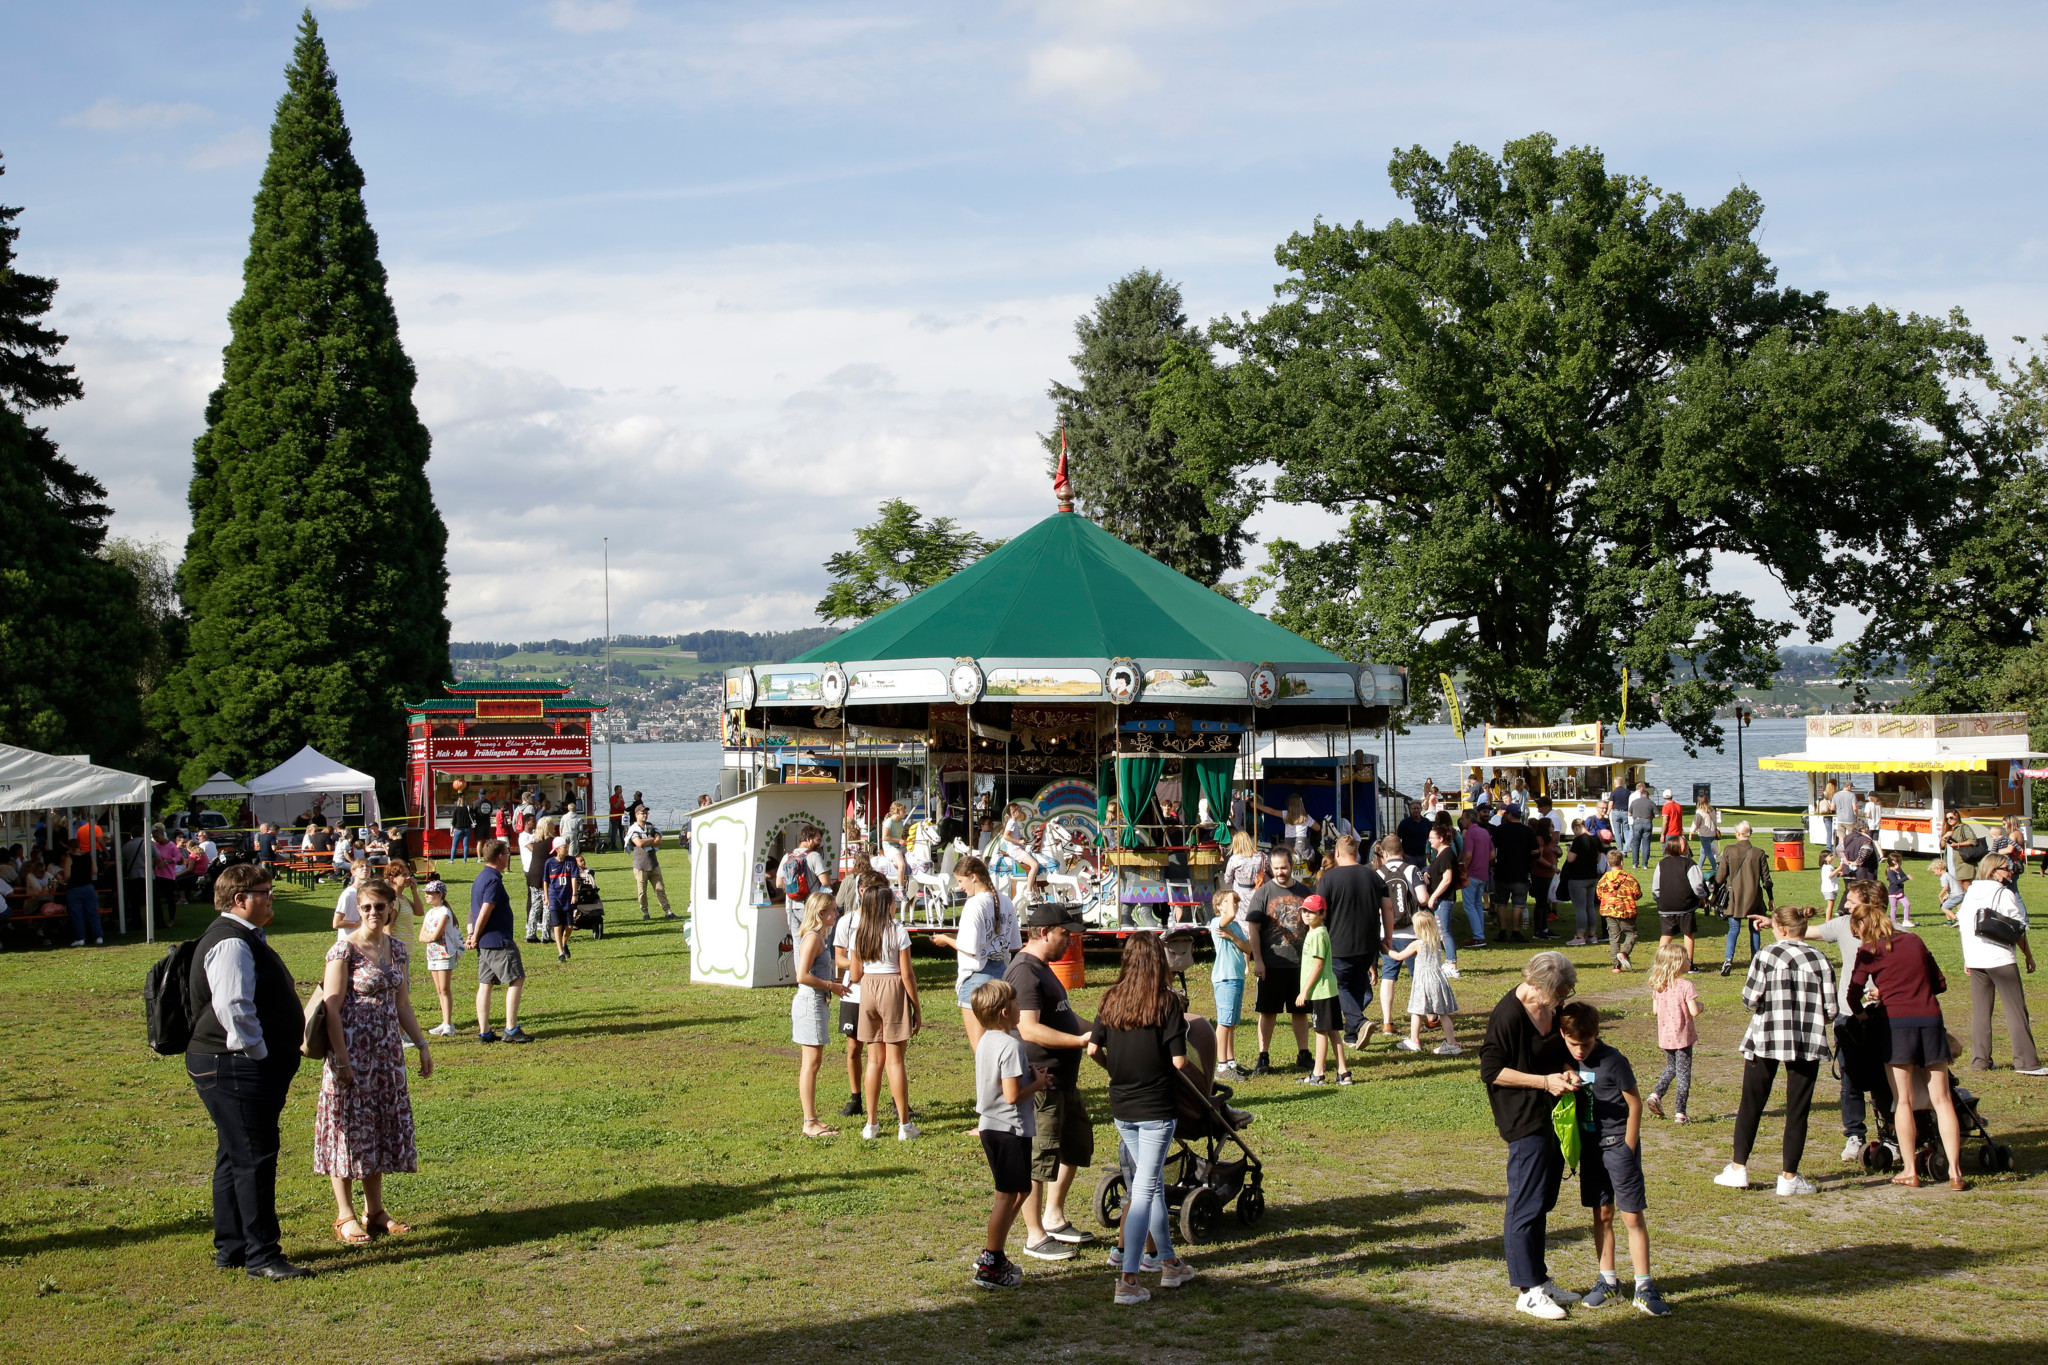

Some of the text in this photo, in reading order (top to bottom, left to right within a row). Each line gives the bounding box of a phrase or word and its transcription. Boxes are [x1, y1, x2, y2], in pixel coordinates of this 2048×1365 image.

[1829, 720, 1854, 735] Getränke
[1900, 720, 1917, 735] Brezel
[474, 749, 518, 758] Frühlingsrolle
[559, 876, 567, 886] 10
